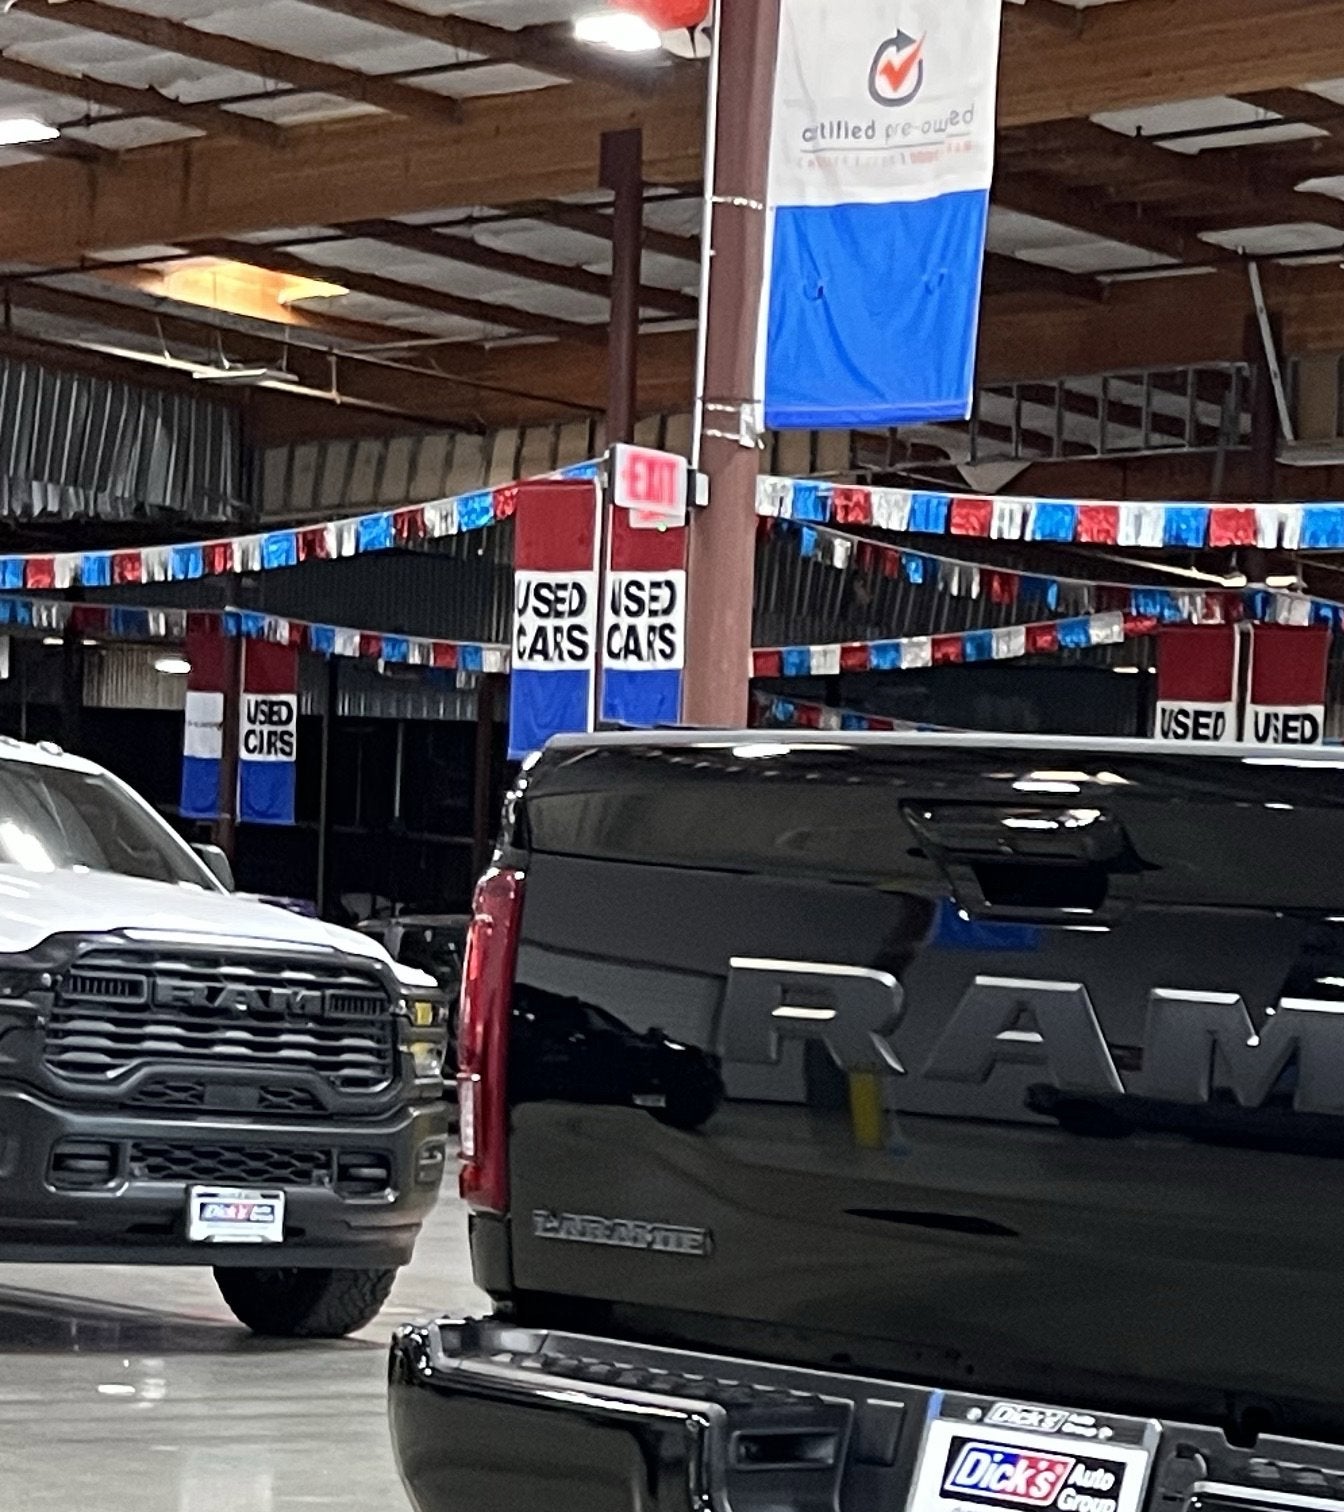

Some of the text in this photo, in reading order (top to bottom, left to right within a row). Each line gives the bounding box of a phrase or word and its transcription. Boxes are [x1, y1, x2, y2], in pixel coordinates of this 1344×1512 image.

[517, 578, 588, 619] USED
[611, 579, 678, 618] USED
[516, 623, 590, 662] CARS
[606, 622, 677, 662] CARS
[246, 699, 294, 726] USED
[1160, 707, 1227, 741] USED
[954, 1449, 1064, 1499] Dick's
[1067, 1462, 1116, 1491] Auto
